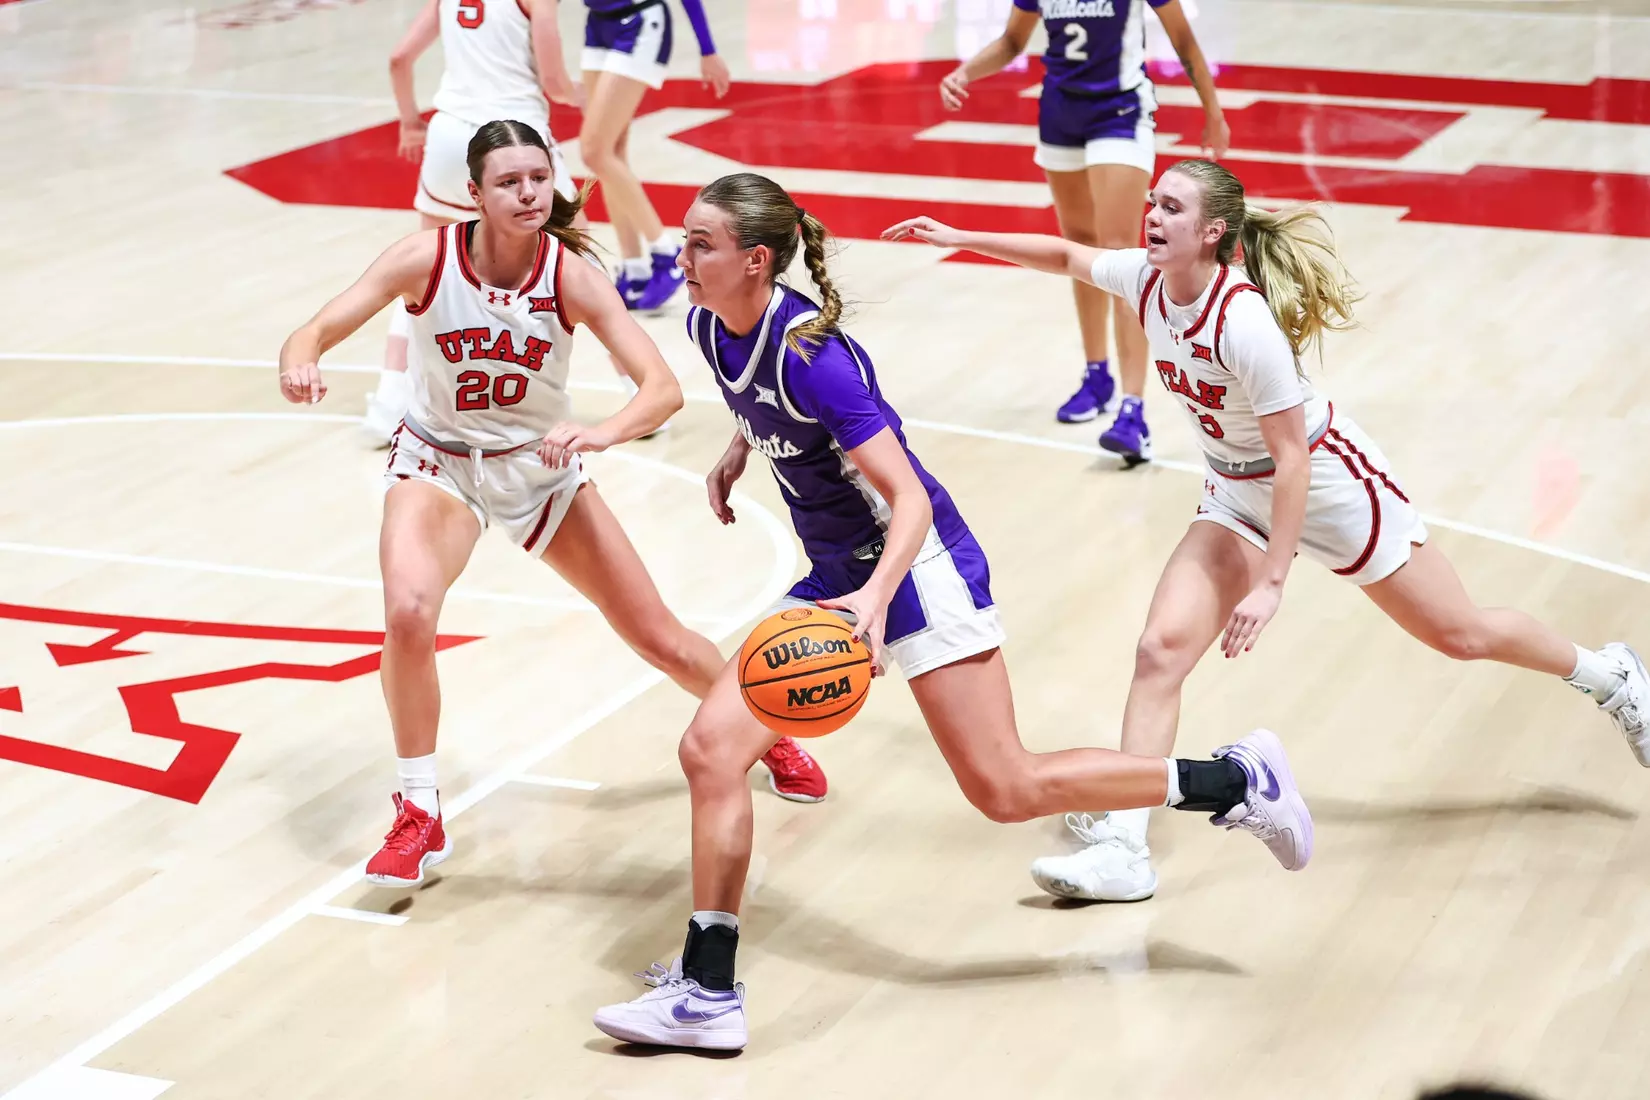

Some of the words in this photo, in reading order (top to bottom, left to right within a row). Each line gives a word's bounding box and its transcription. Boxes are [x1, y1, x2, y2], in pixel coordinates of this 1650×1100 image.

[1064, 23, 1088, 60] 2
[435, 327, 553, 371] UTAH
[456, 370, 529, 411] 20
[763, 637, 852, 669] Wilson
[787, 676, 852, 706] NCAA
